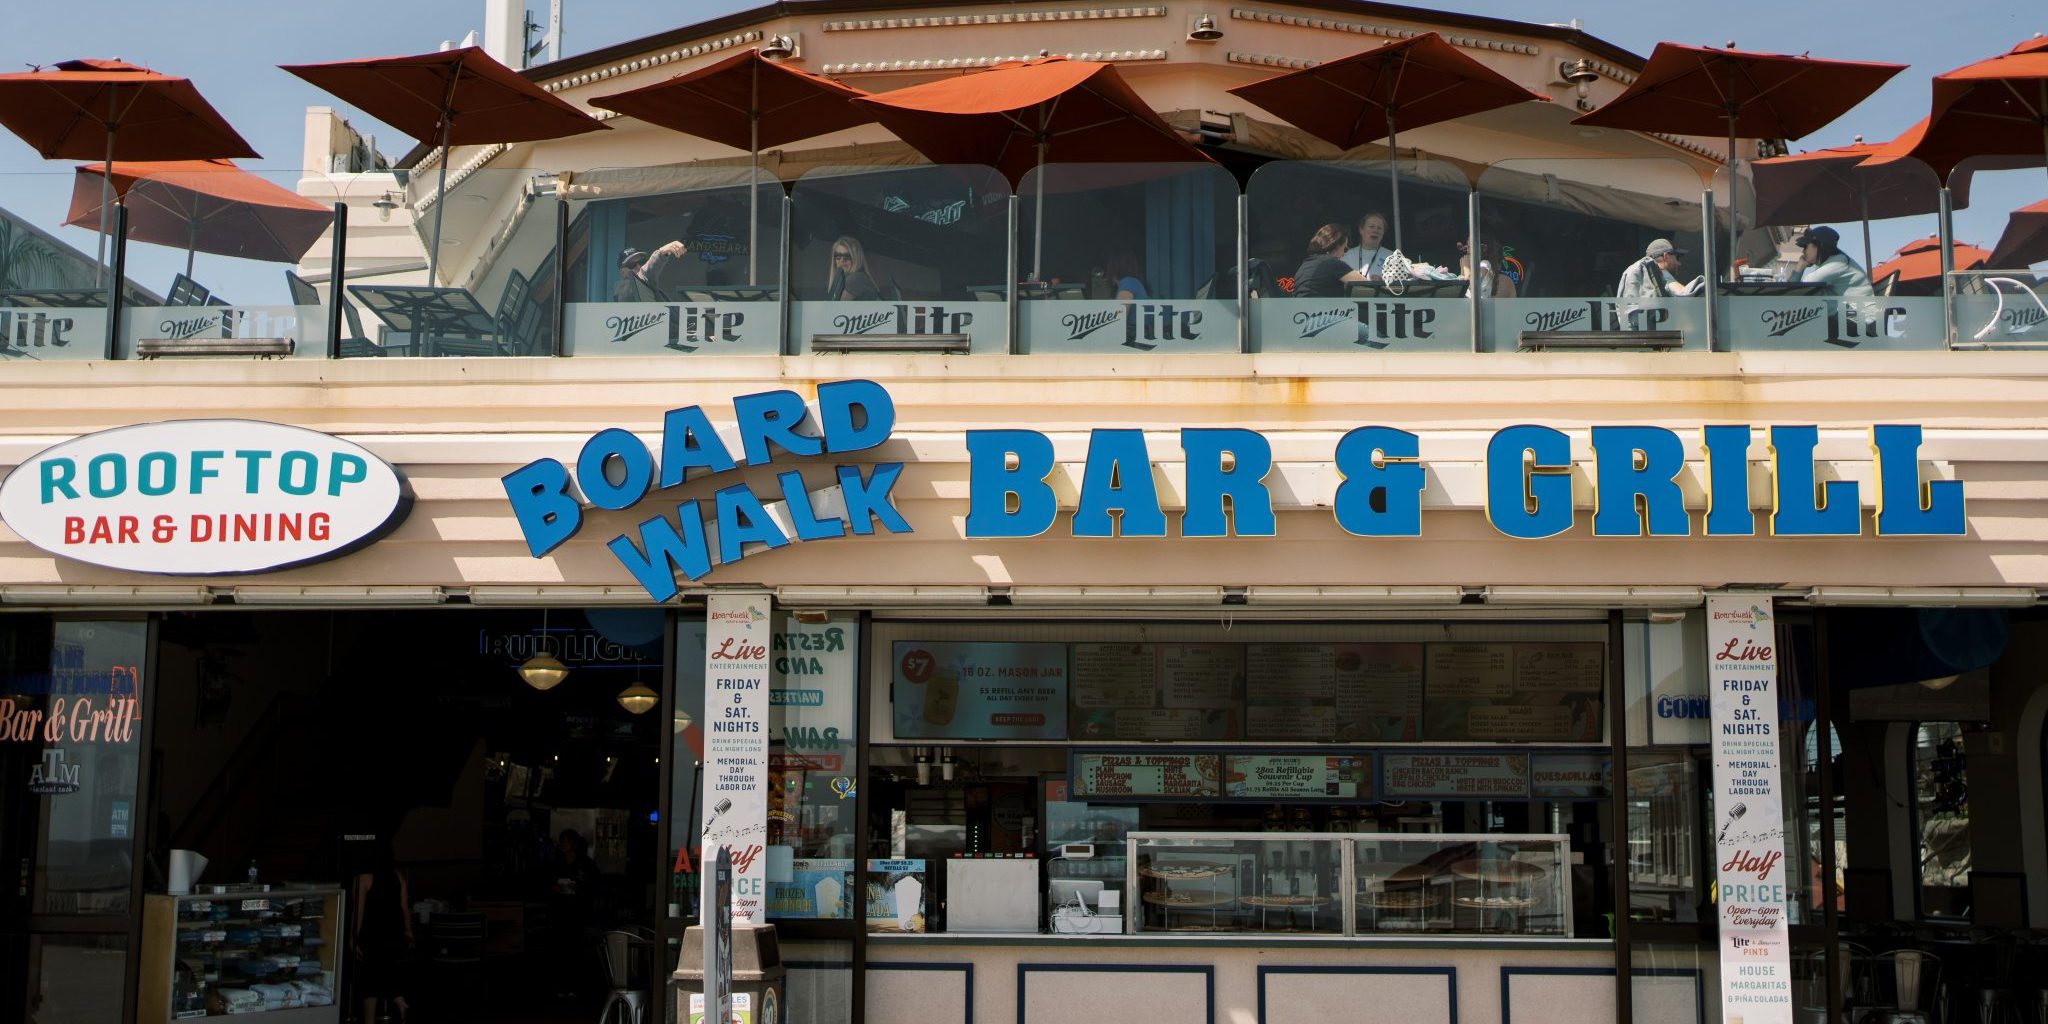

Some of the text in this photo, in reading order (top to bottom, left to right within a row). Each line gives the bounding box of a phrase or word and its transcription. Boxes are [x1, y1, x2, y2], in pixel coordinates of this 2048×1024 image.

[687, 240, 752, 256] ANDSHARK
[833, 304, 972, 334] Miller Lite
[1525, 306, 1589, 331] Miller
[1761, 299, 1907, 348] Miller Lite
[160, 316, 220, 339] Miller
[606, 305, 744, 353] Miller Lite
[1061, 303, 1202, 351] Miller Lite
[1293, 301, 1436, 349] Miller Lite
[500, 378, 897, 559] BOARD
[39, 447, 368, 504] ROOFTOP
[964, 423, 1967, 539] BAR & GRILL
[64, 512, 331, 545] BAR & DINING
[606, 461, 915, 603] WALK
[711, 611, 749, 620] Boardwalk
[1713, 609, 1753, 620] Boardwalk
[711, 637, 766, 660] Live
[1715, 637, 1772, 661] Live
[907, 657, 929, 676] $7
[962, 667, 1062, 678] 16 OZ. MASON JAR
[716, 679, 761, 690] FRIDAY
[1723, 680, 1769, 691] FRIDAY
[733, 693, 742, 704] &
[1742, 694, 1750, 705] &
[725, 707, 750, 718] SAT.
[1734, 709, 1760, 720] SAT.
[0, 697, 134, 742] Bar & Grill
[713, 721, 759, 732] NIGHTS
[1723, 723, 1770, 735] NIGHTS
[28, 748, 80, 786] ATM
[717, 758, 757, 766] MEMORIAL
[1102, 756, 1131, 766] PIZZAS
[1145, 756, 1190, 766] TOPPINGS
[1411, 757, 1441, 767] PIZZAS
[1455, 757, 1500, 767] TOPPINGS
[1728, 761, 1770, 769] MEMORIAL
[729, 766, 744, 774] DAY
[1276, 766, 1314, 774] Refillable
[1296, 773, 1312, 781] Cup
[1534, 771, 1601, 782] QUESADILLAS
[715, 783, 756, 791] LABOR DAY
[112, 809, 129, 822] ATM
[729, 844, 763, 874] alf
[1722, 850, 1782, 881] Half
[1733, 915, 1777, 929] Everyday
[1732, 937, 1750, 949] Lite
[1743, 948, 1769, 956] PINTS
[1739, 966, 1775, 976] HOUSE
[1730, 981, 1787, 990] MARGARITAS
[1734, 994, 1753, 1003] PIÑA
[1754, 995, 1789, 1003] COLADAS
